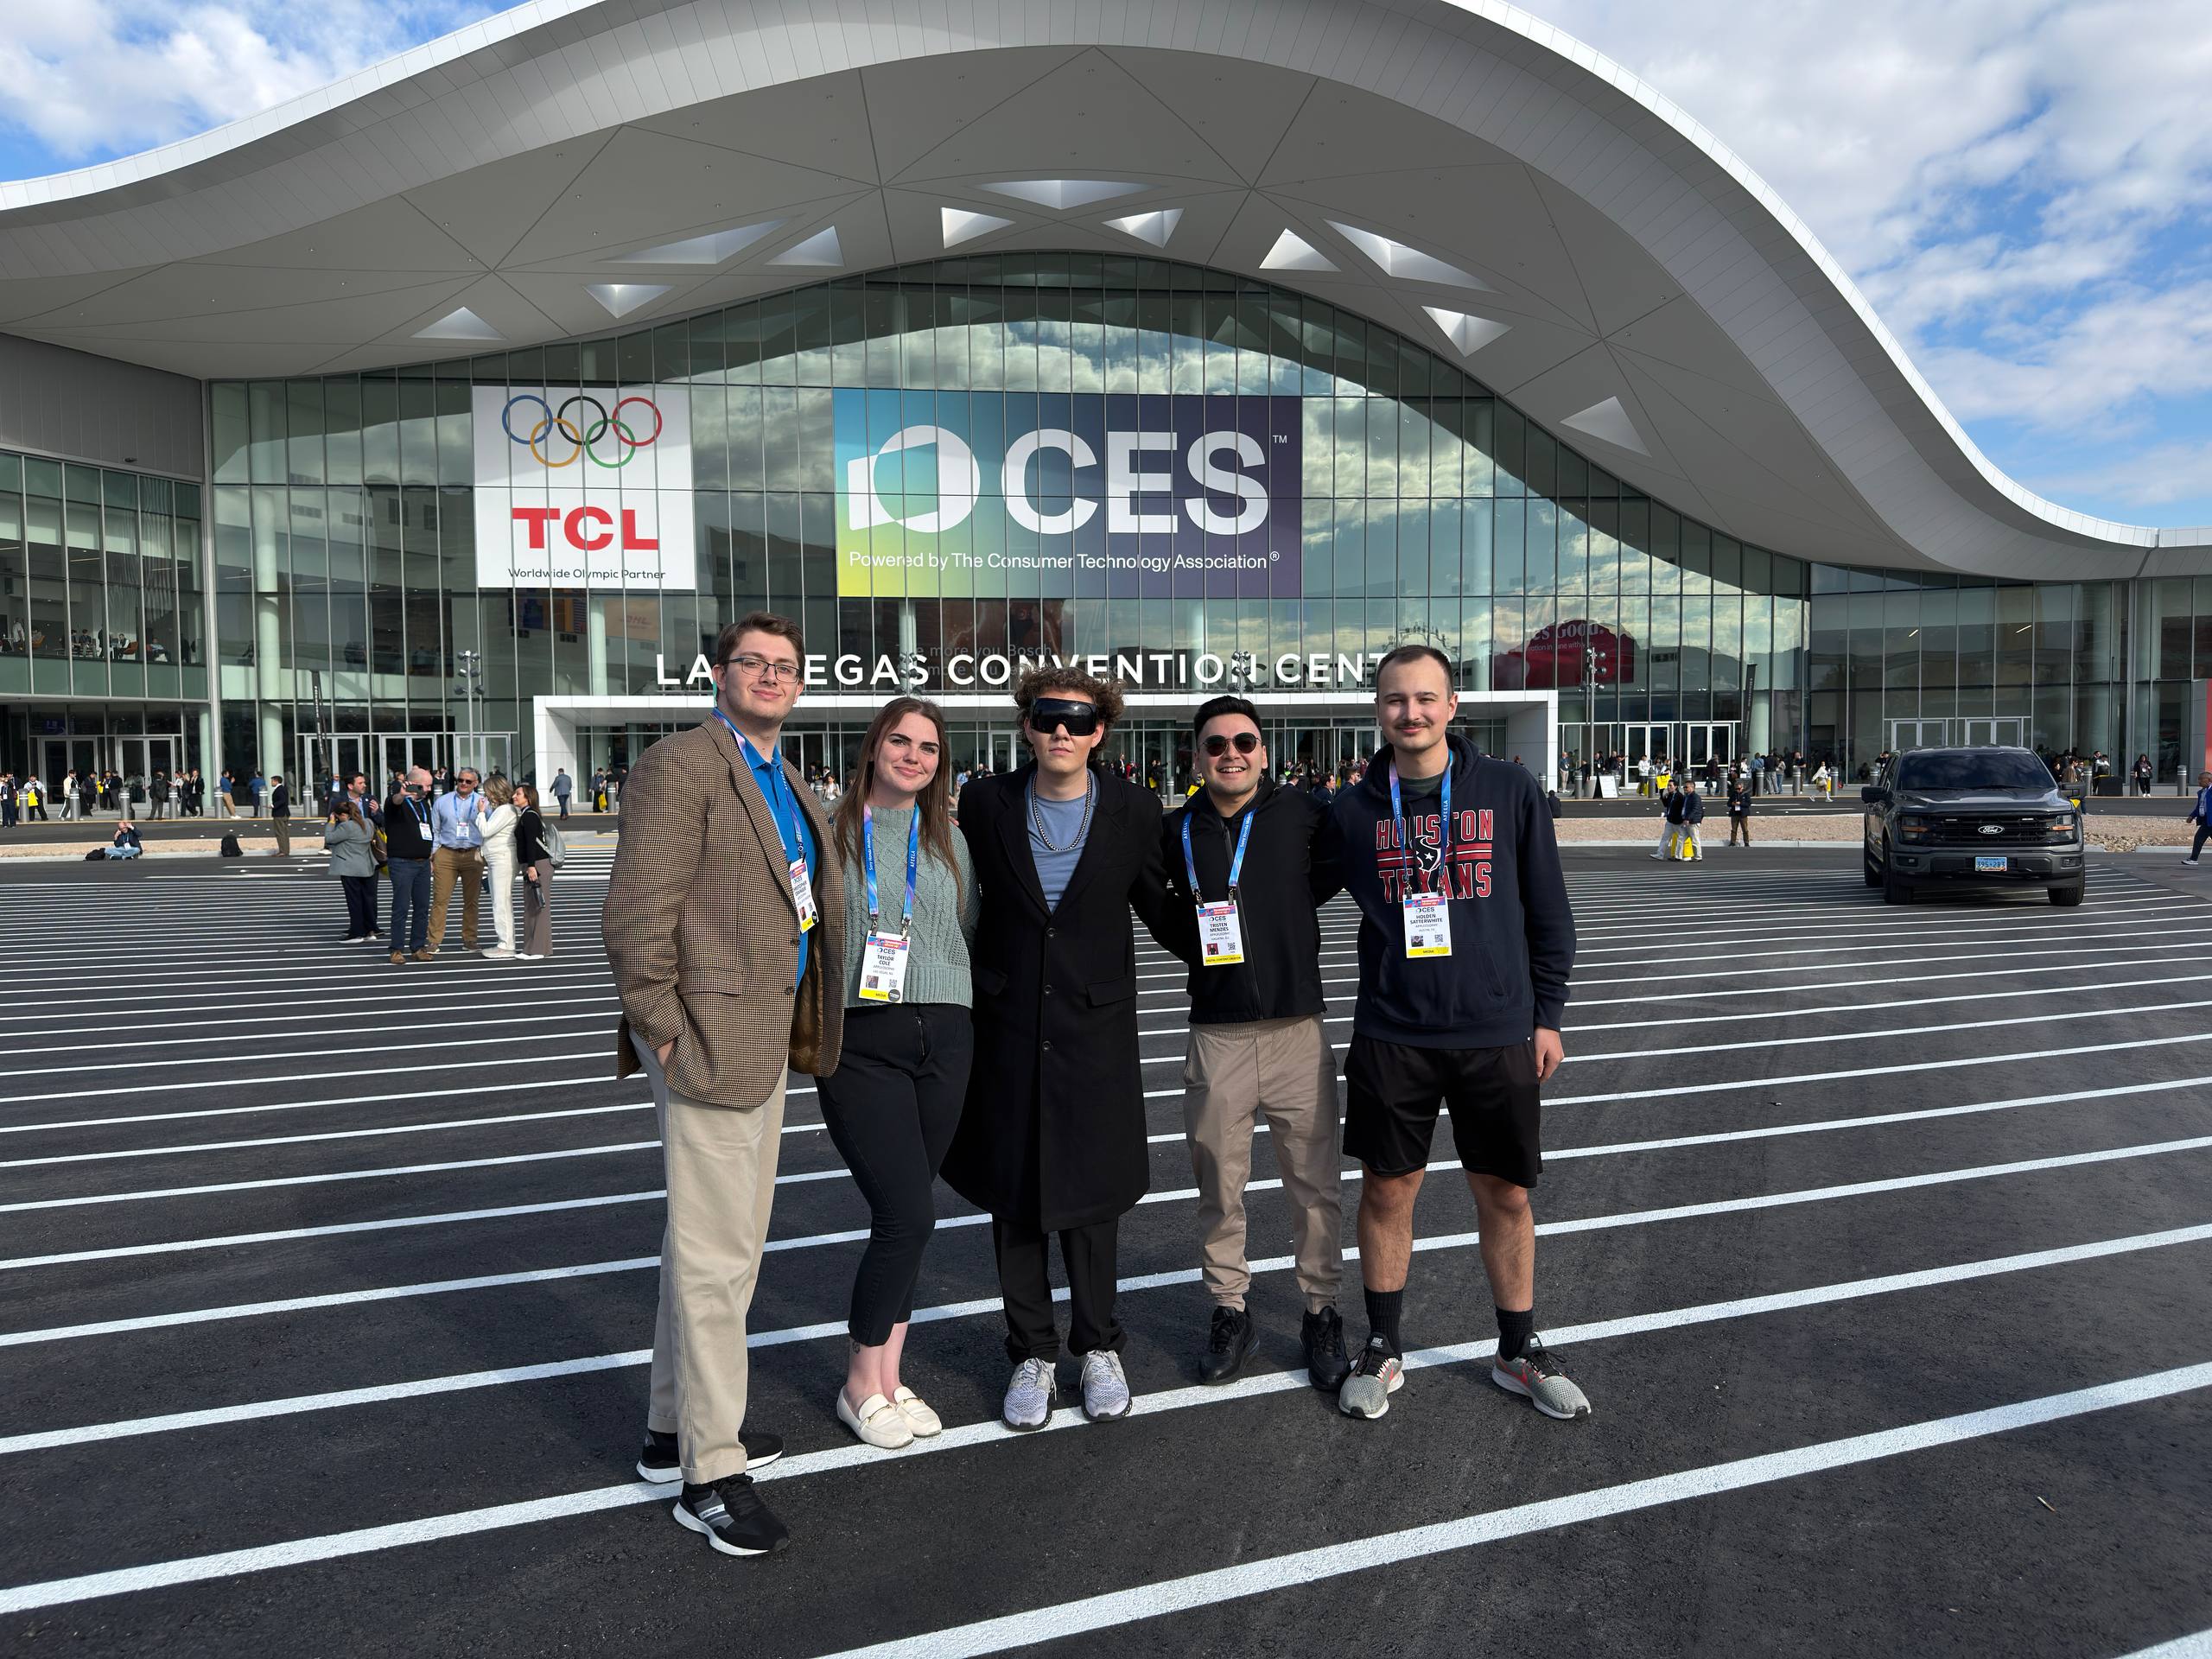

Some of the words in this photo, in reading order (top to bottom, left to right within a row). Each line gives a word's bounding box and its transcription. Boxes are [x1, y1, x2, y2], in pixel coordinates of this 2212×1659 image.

[1001, 429, 1268, 536] CES
[512, 506, 659, 551] TCL
[508, 568, 570, 578] Worldwide
[573, 569, 619, 580] Olympic
[621, 569, 666, 579] Partner
[849, 551, 924, 567] Powered
[929, 553, 949, 571] by
[950, 552, 983, 568] The
[988, 553, 1073, 569] Consumer
[1077, 554, 1171, 572] Technology
[930, 645, 969, 656] more
[657, 654, 716, 685] LA
[804, 653, 929, 685] EGAS
[1376, 810, 1493, 850] HOUSON
[1378, 862, 1492, 904] TEXANS
